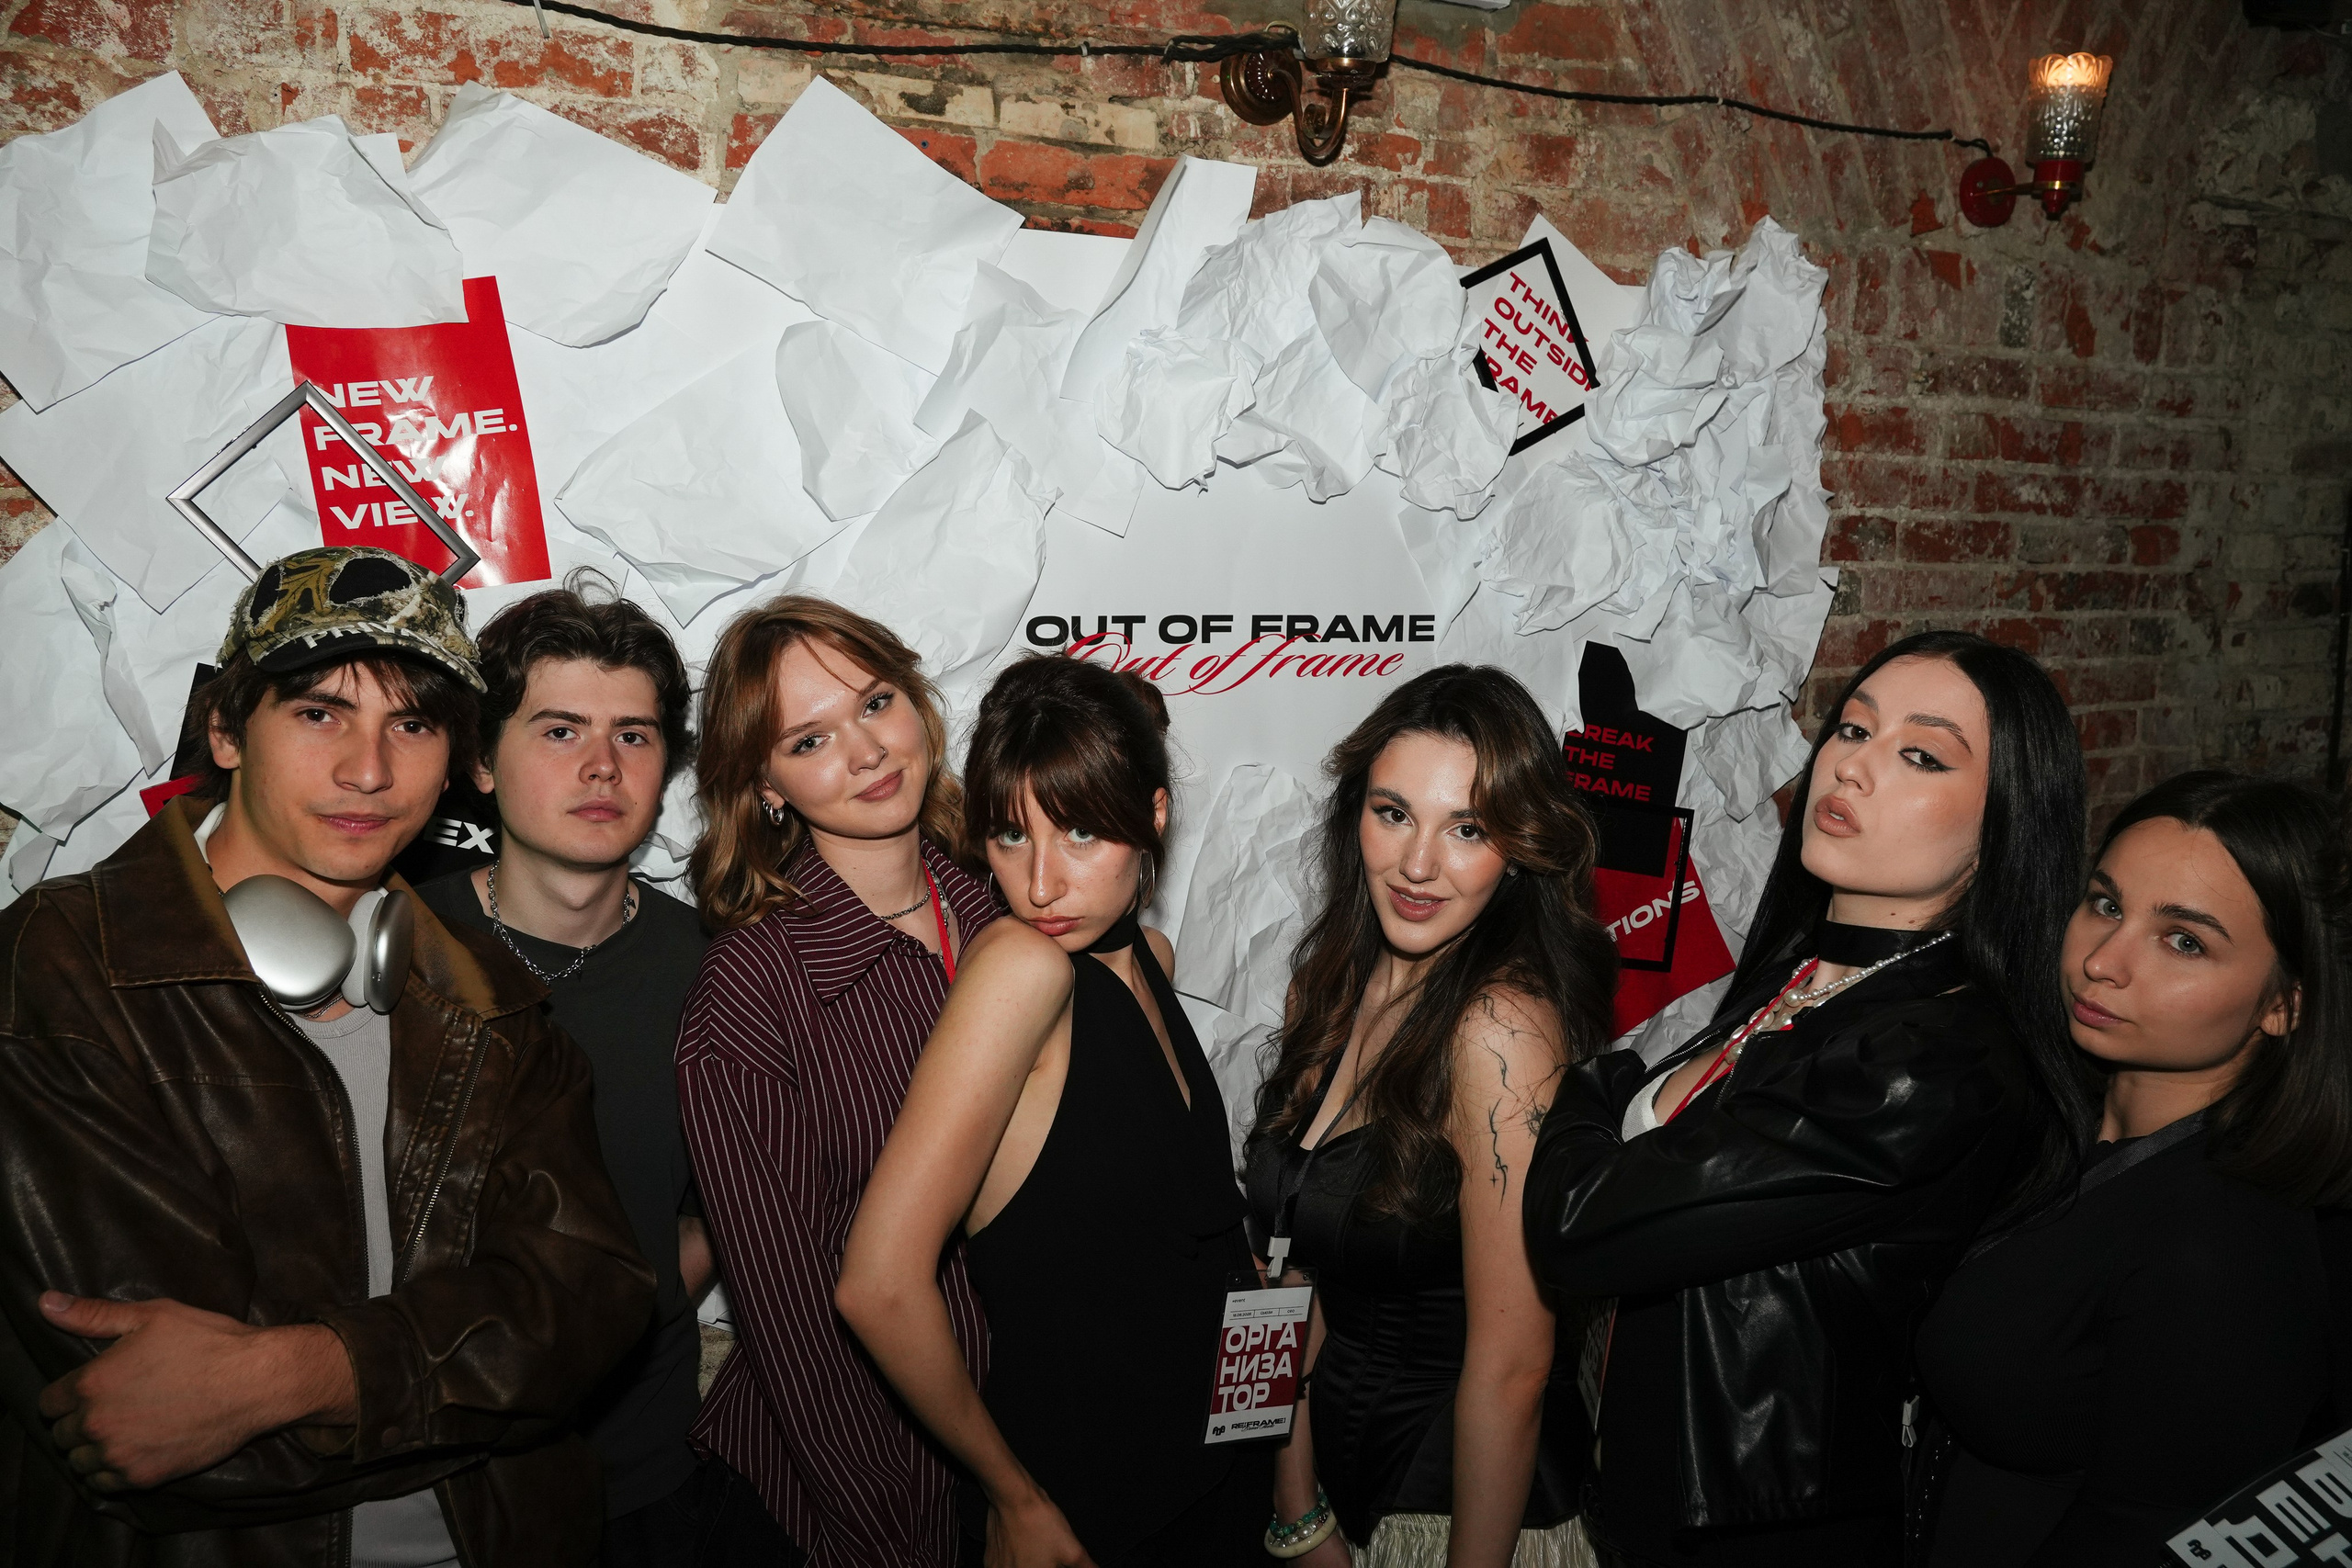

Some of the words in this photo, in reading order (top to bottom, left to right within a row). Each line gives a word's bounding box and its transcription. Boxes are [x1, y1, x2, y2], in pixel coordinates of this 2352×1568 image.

[1484, 317, 1538, 376] THE
[1494, 297, 1591, 391] OUTSID
[315, 376, 435, 409] NEW
[313, 408, 518, 451] FRAME.
[321, 456, 446, 491] NEW
[1026, 615, 1147, 647] OUT
[1159, 615, 1234, 644] OF
[1251, 615, 1435, 643] FRAME
[1162, 633, 1286, 695] of
[1189, 633, 1405, 695] frame
[1564, 745, 1616, 770] THE
[1225, 1322, 1298, 1354] ОРГА
[1219, 1351, 1293, 1385] НИЗА
[1217, 1382, 1271, 1414] ТОР
